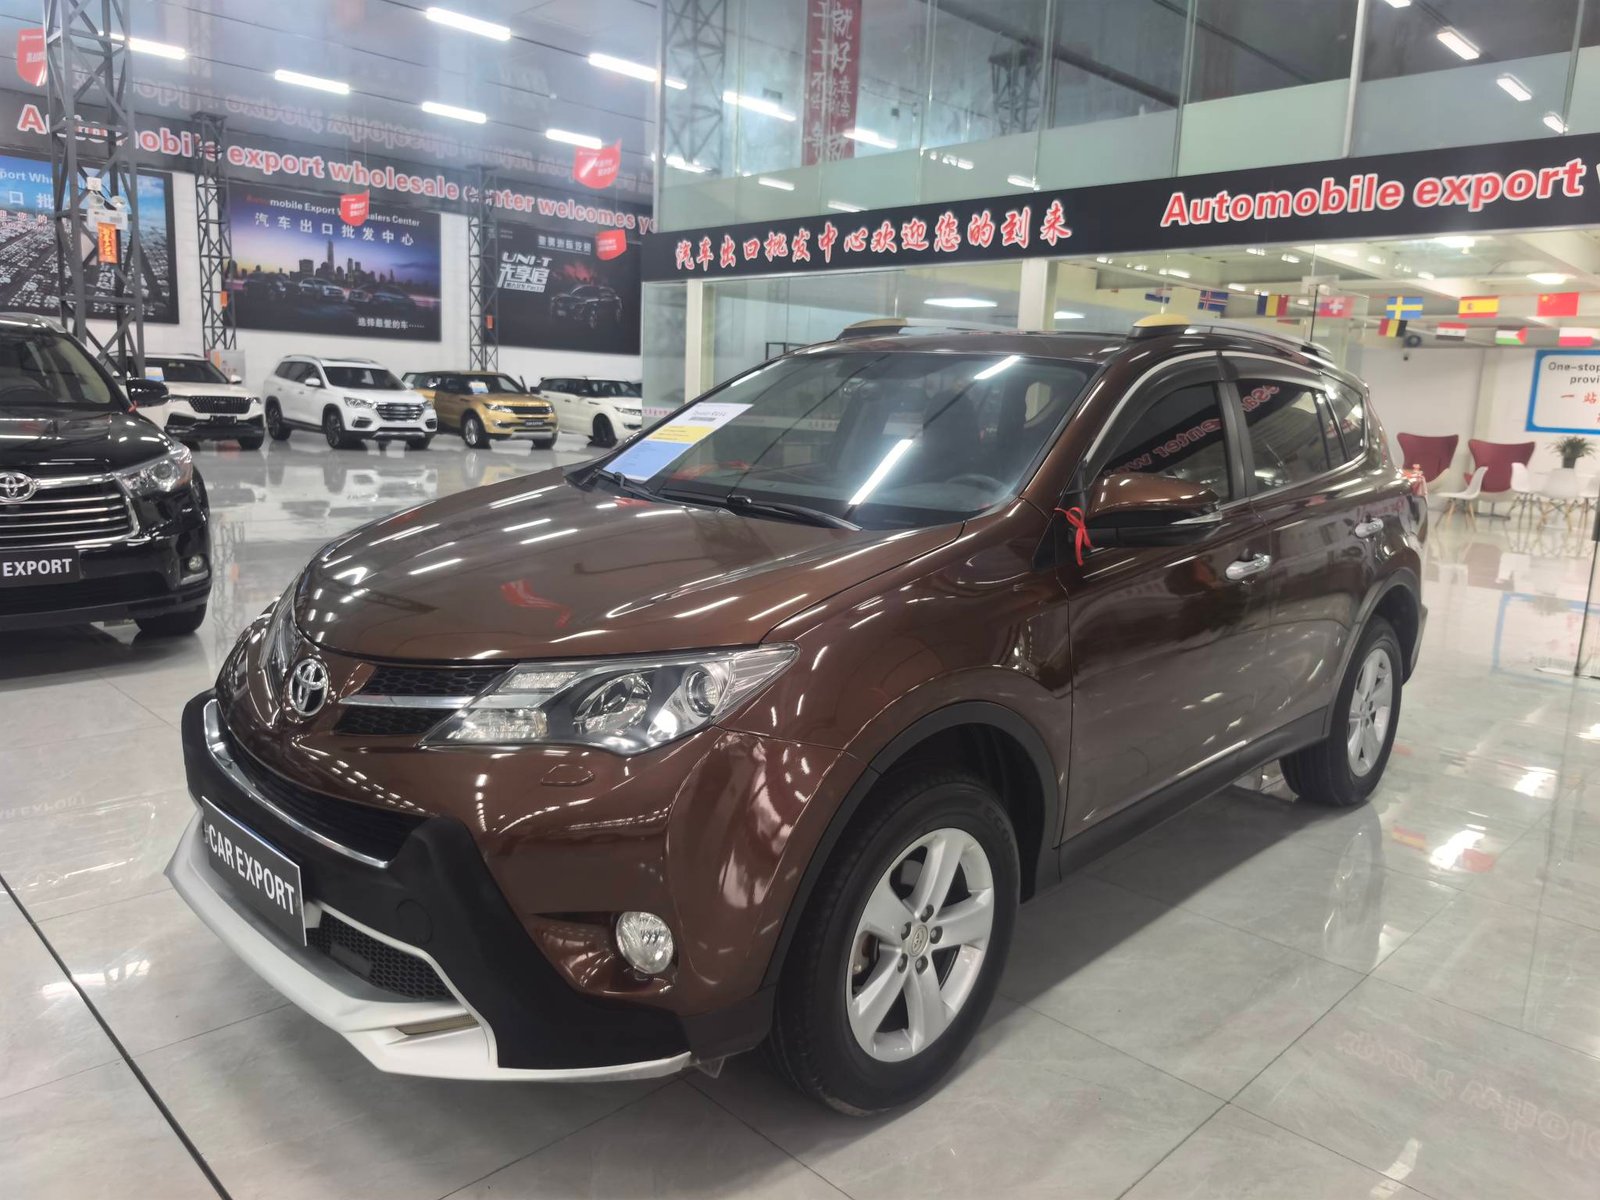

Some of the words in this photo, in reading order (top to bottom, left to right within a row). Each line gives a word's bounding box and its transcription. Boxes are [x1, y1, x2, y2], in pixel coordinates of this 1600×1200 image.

[227, 145, 324, 178] export
[328, 160, 459, 199] wholesale
[537, 197, 636, 229] welcomes
[1160, 173, 1404, 227] Automobile
[1412, 157, 1588, 212] export
[304, 202, 336, 215] Export
[255, 212, 414, 247] 汽车出口批发中心
[502, 252, 553, 267] UNI-T
[2, 558, 73, 577] EXPORT
[208, 823, 236, 870] CAR
[235, 845, 295, 915] EXPORT
